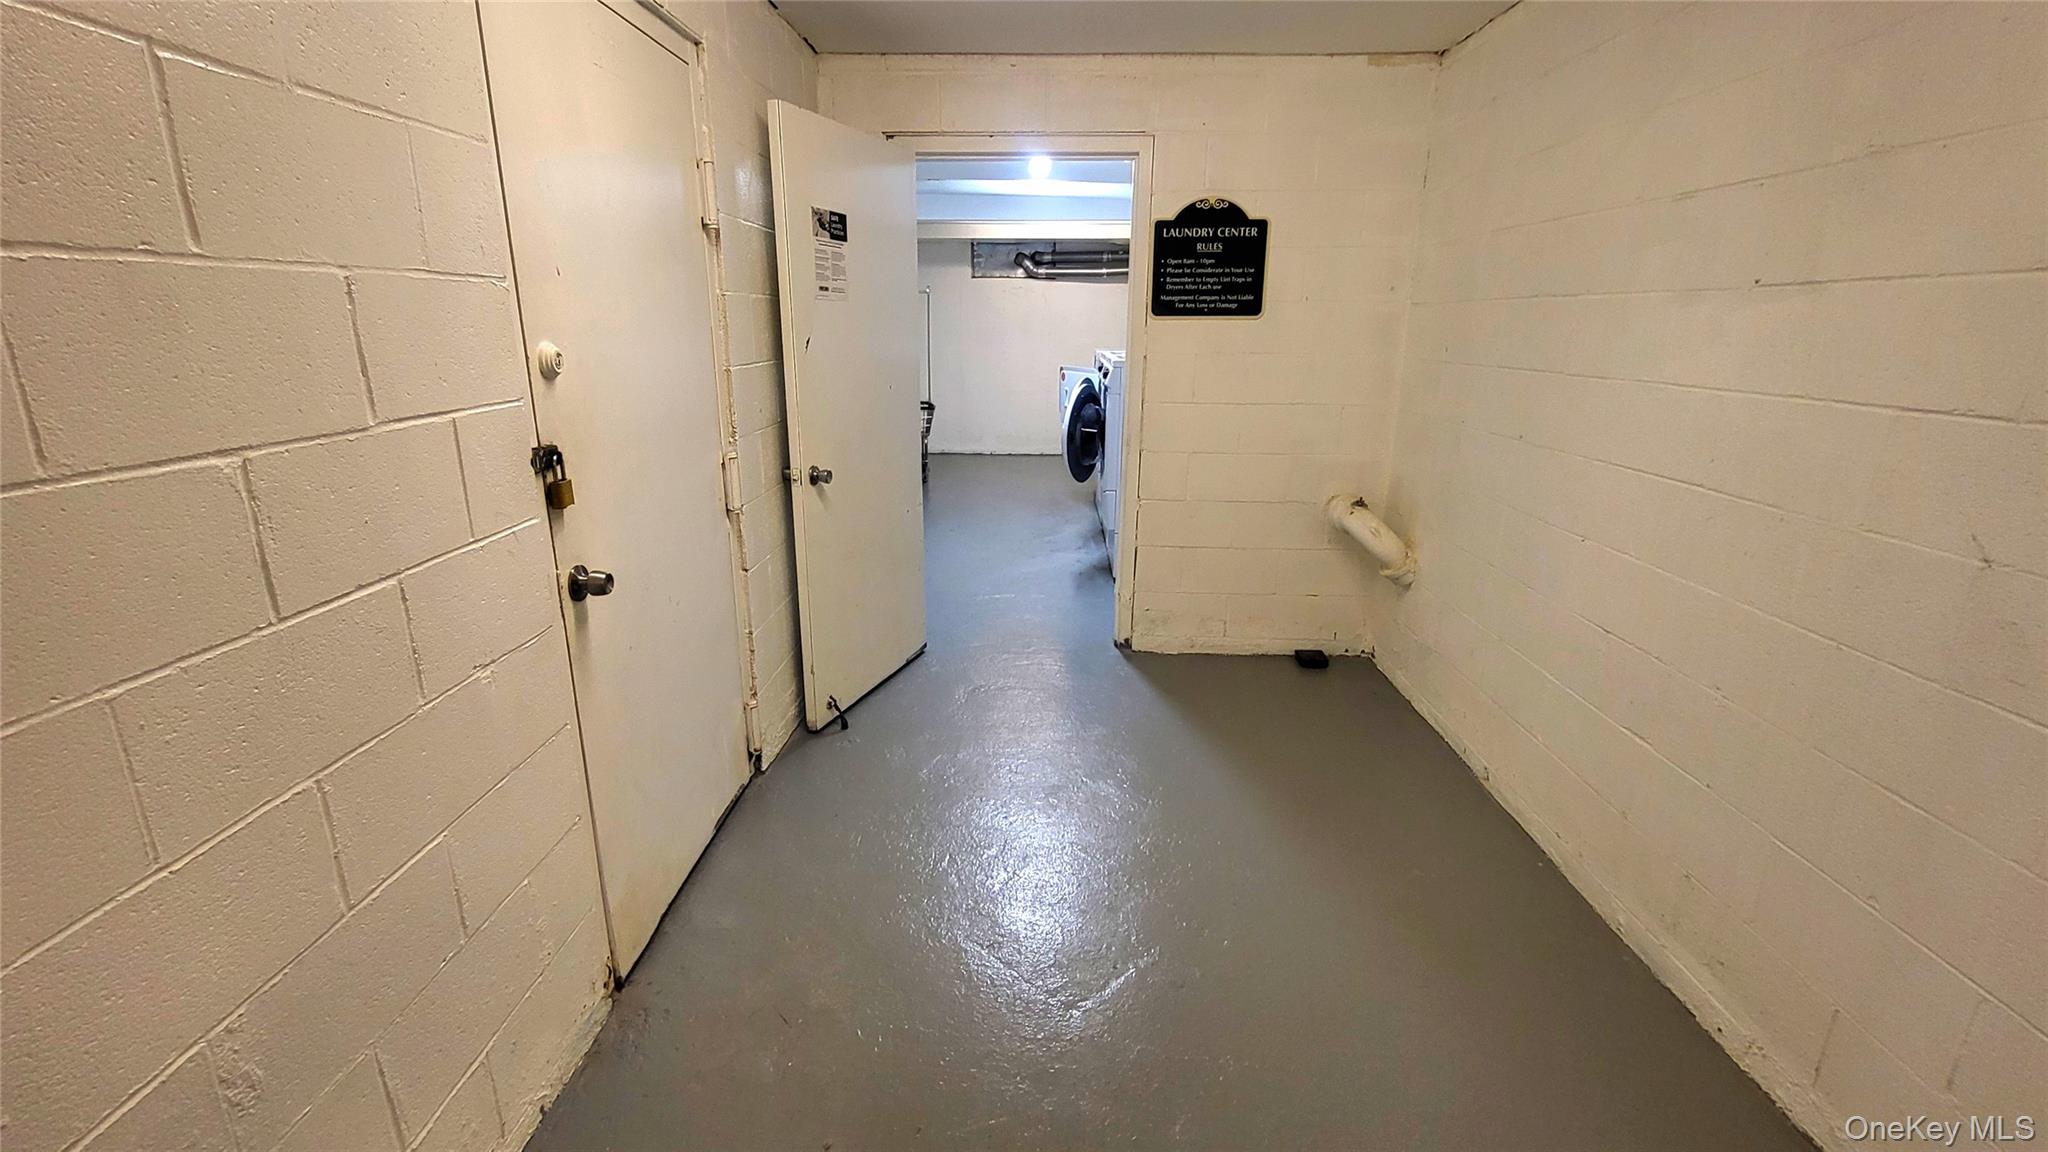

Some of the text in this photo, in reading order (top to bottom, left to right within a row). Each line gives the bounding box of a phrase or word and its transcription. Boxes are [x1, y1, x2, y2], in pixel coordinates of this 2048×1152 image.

[1163, 227, 1258, 237] LAUNDRY CENTER
[1197, 243, 1223, 251] RULES
